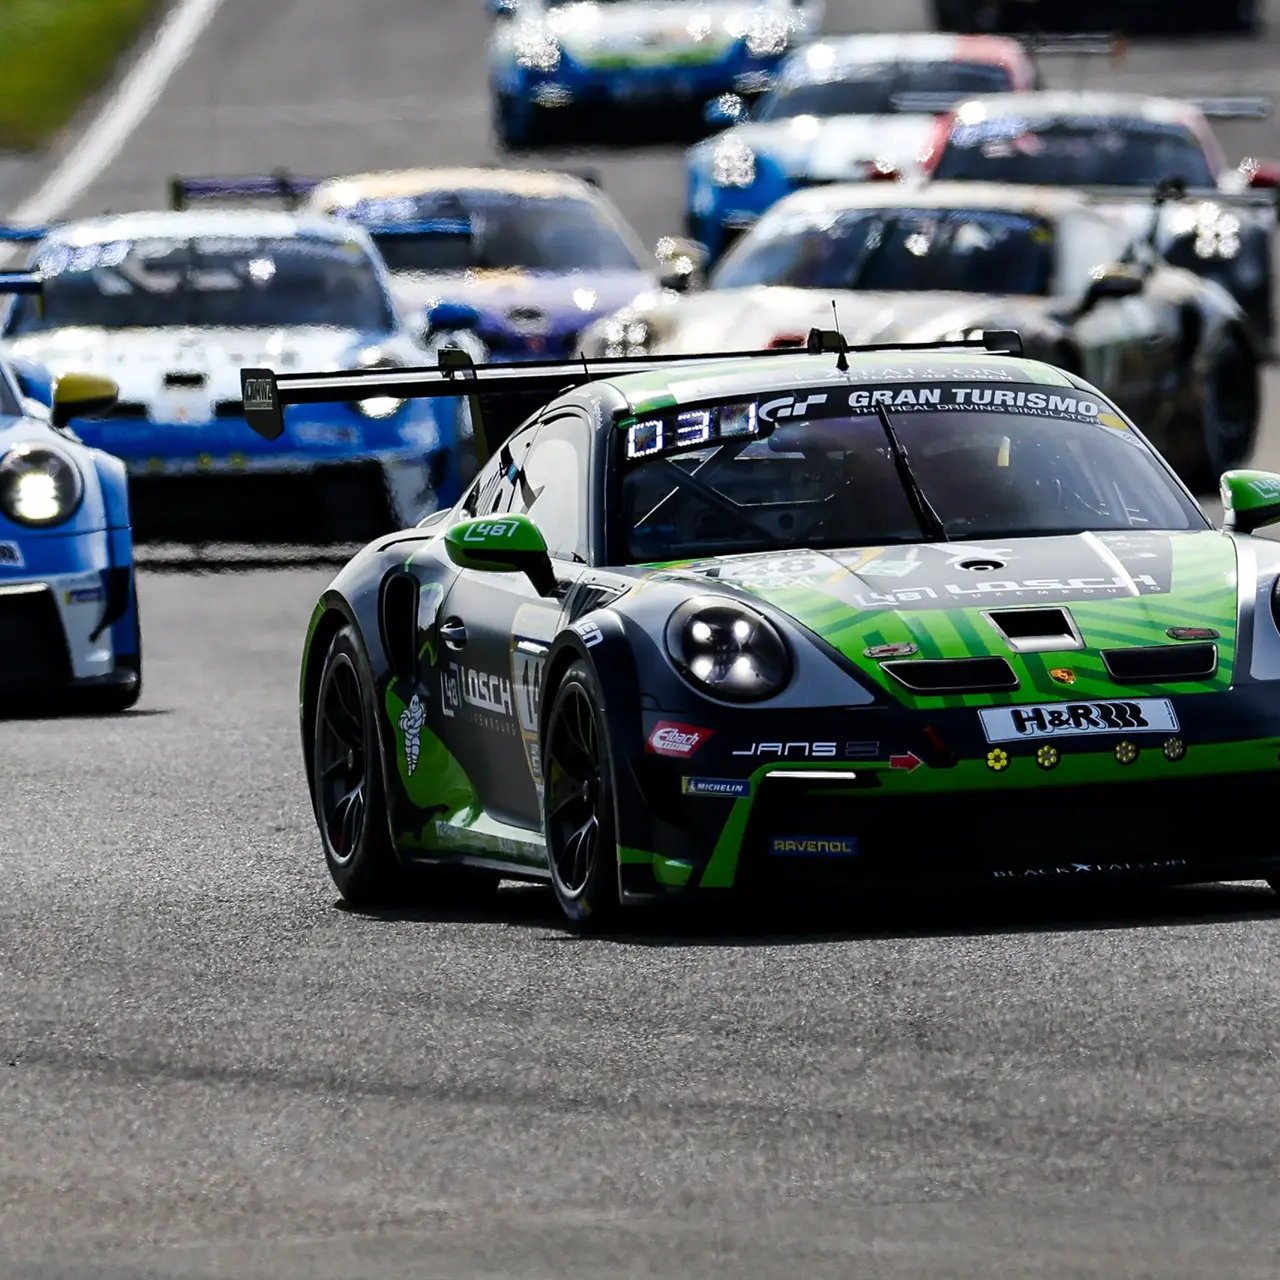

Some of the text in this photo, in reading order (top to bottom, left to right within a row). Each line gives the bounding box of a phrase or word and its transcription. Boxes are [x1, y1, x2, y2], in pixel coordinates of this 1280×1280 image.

[848, 387, 1099, 417] GRAN TURISMO
[890, 403, 933, 412] REAL
[935, 402, 1004, 414] DRIVING
[1008, 405, 1102, 425] SIMULATOR
[627, 401, 760, 461] 031
[943, 574, 1159, 595] LOSCH
[952, 585, 1161, 600] LUXEMBOUG
[461, 665, 513, 717] LOSCH
[1010, 704, 1110, 736] H&R
[652, 727, 700, 751] Eibach
[732, 742, 838, 757] JANS
[696, 782, 744, 793] MICHELIN
[773, 840, 853, 853] RAVENOL
